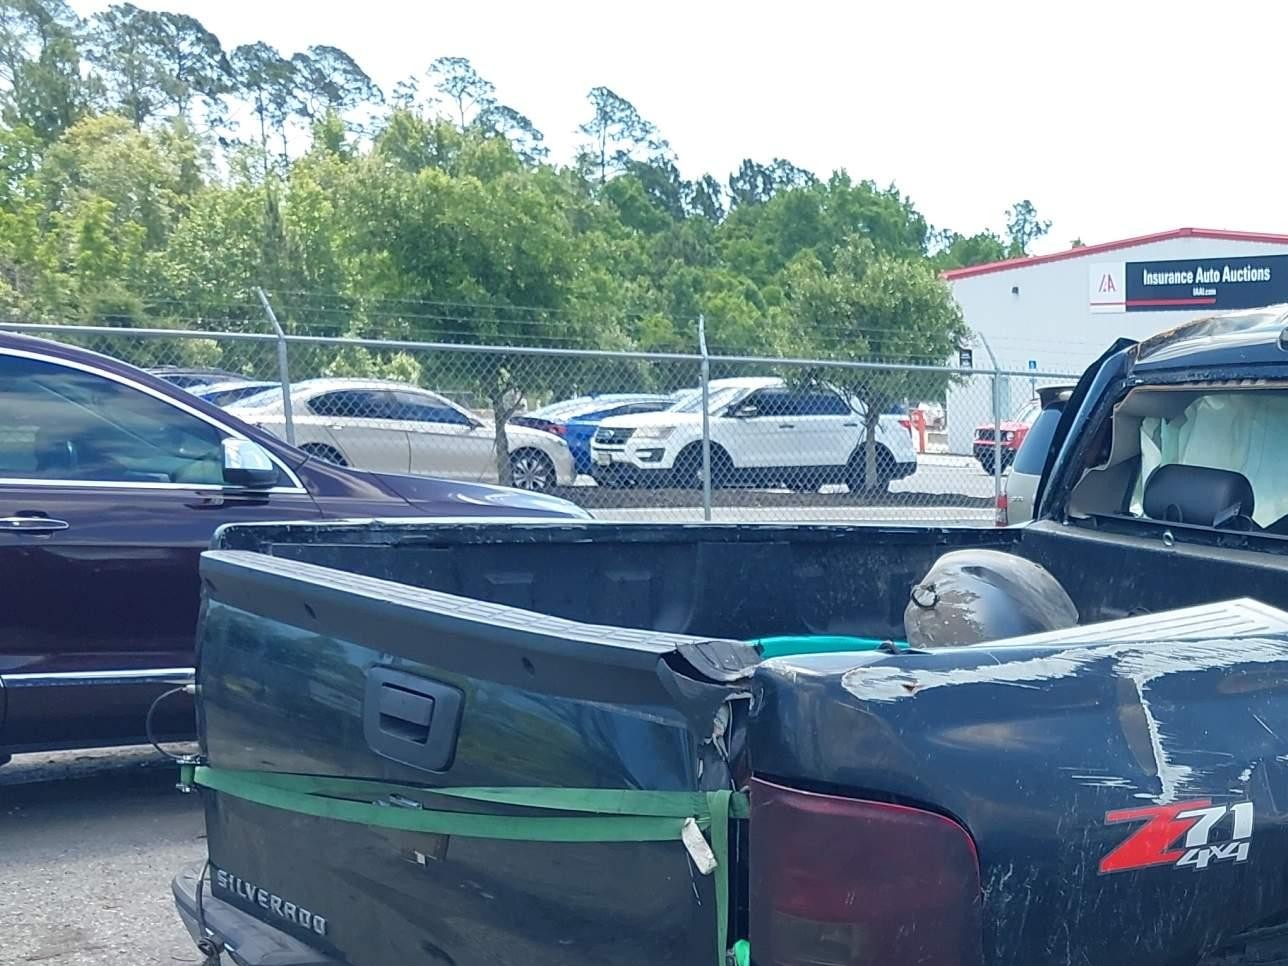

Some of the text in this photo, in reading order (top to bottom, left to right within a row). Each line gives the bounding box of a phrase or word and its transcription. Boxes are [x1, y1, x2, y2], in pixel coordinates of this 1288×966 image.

[1143, 265, 1271, 285] Insurance Auto Auctions
[1100, 798, 1254, 874] Z71
[216, 868, 328, 935] SILVERADO
